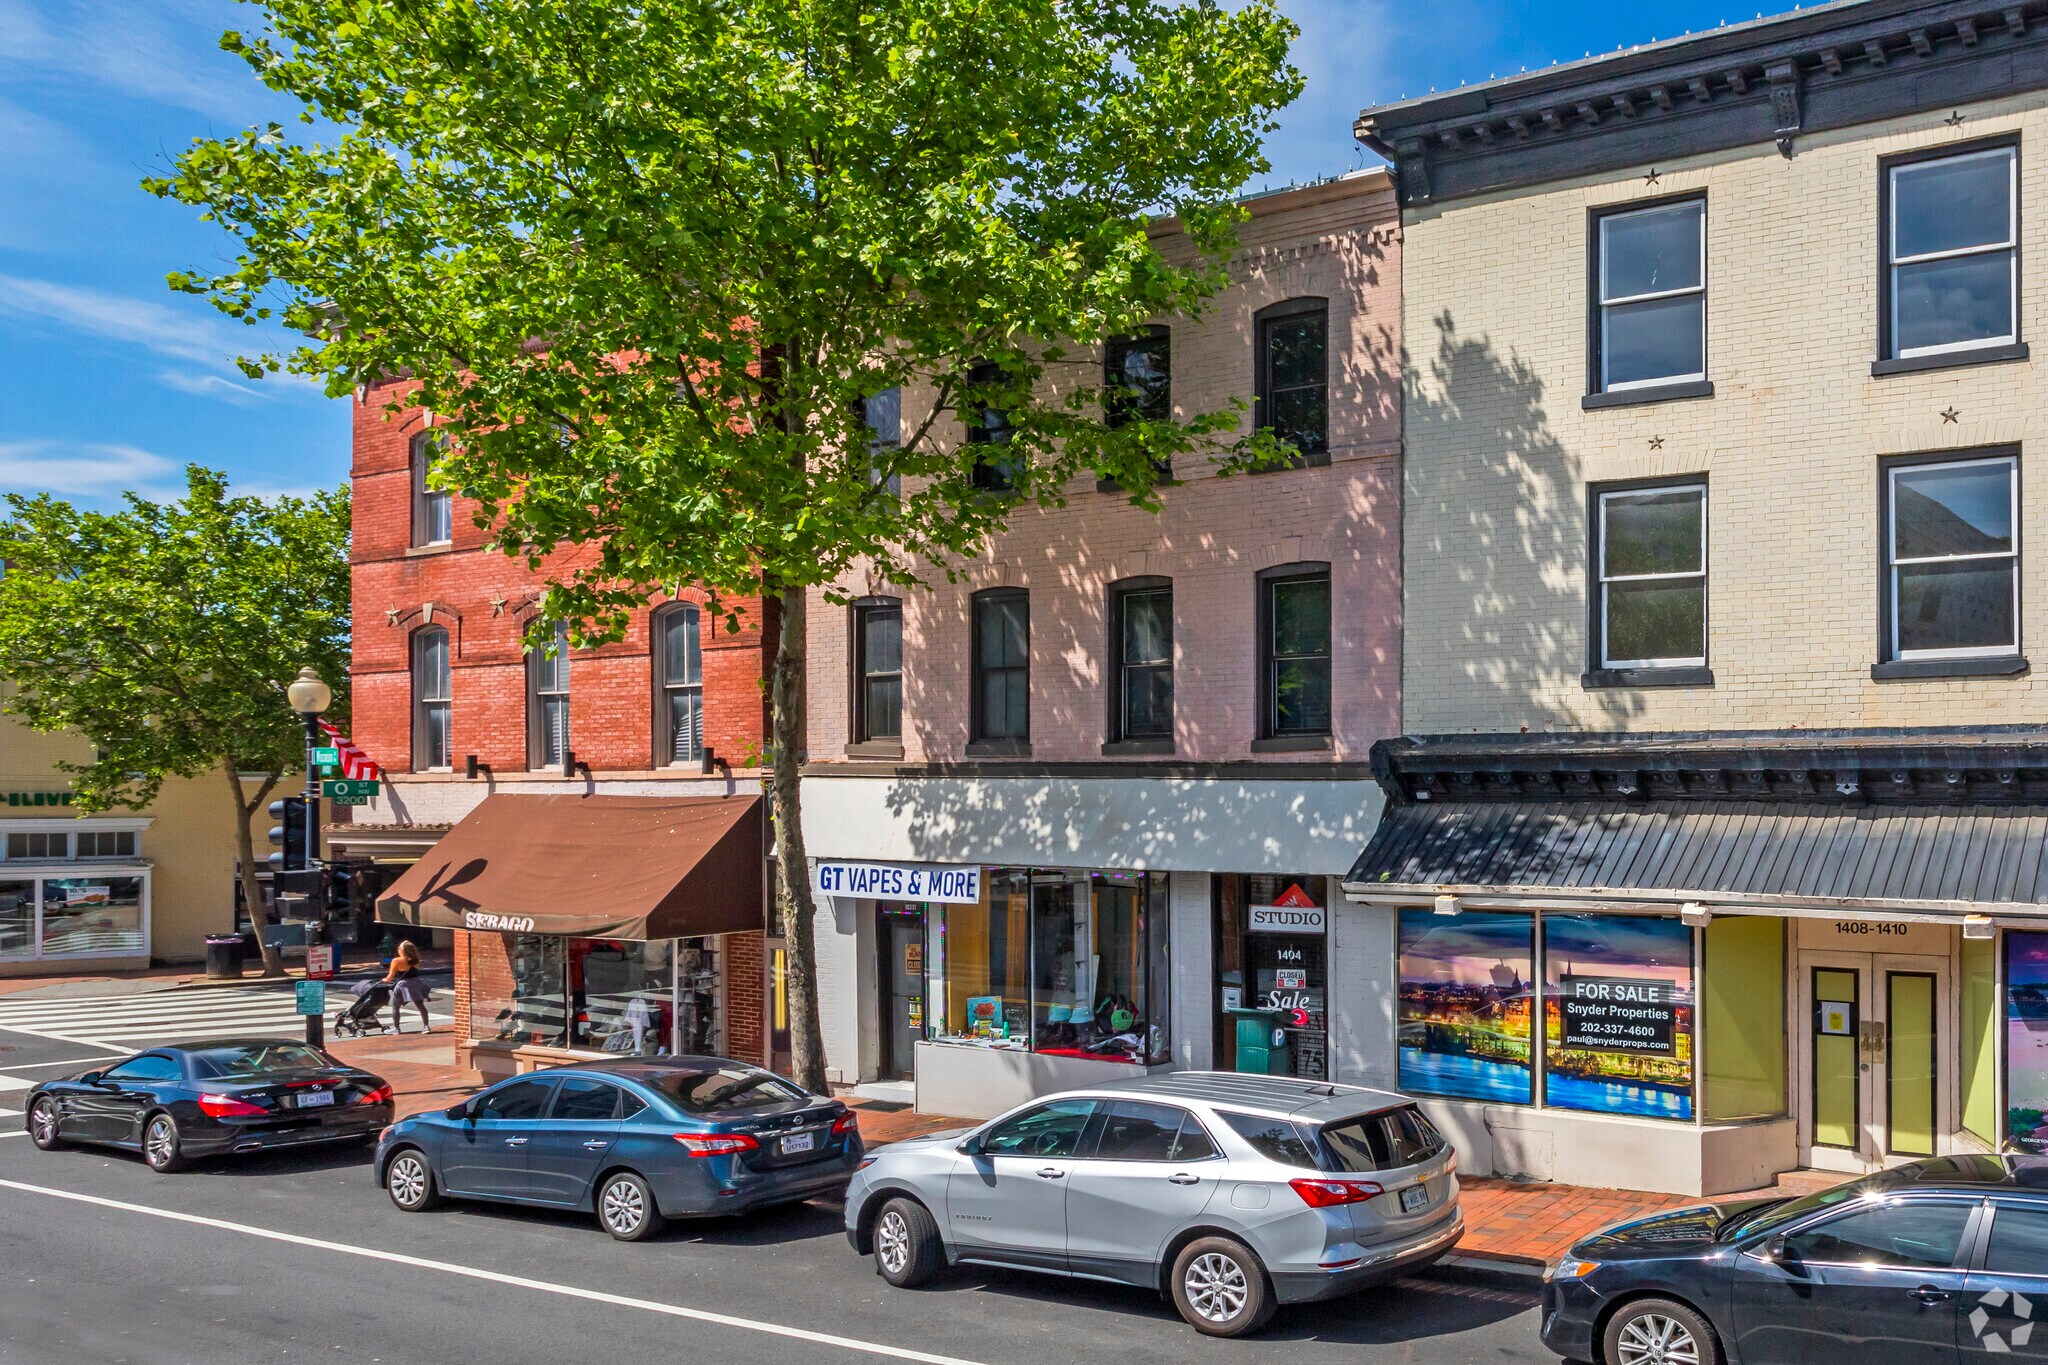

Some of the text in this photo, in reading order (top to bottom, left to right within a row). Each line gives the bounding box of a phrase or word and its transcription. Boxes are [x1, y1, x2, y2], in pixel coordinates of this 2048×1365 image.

[334, 782, 348, 795] O
[336, 795, 365, 805] 3200
[820, 866, 977, 898] GT VAPES & MORE
[1254, 910, 1322, 926] STUDIO
[1835, 921, 1908, 936] 1408-1410
[1277, 949, 1302, 961] 1404
[1279, 970, 1304, 980] CLOSED
[1266, 990, 1310, 1010] Sale
[1575, 982, 1660, 1003] FOR SALE
[1567, 1002, 1669, 1020] Snyder Properties
[1580, 1022, 1656, 1037] 202-337-4600
[1566, 1035, 1670, 1050] paul@snyderprops.com
